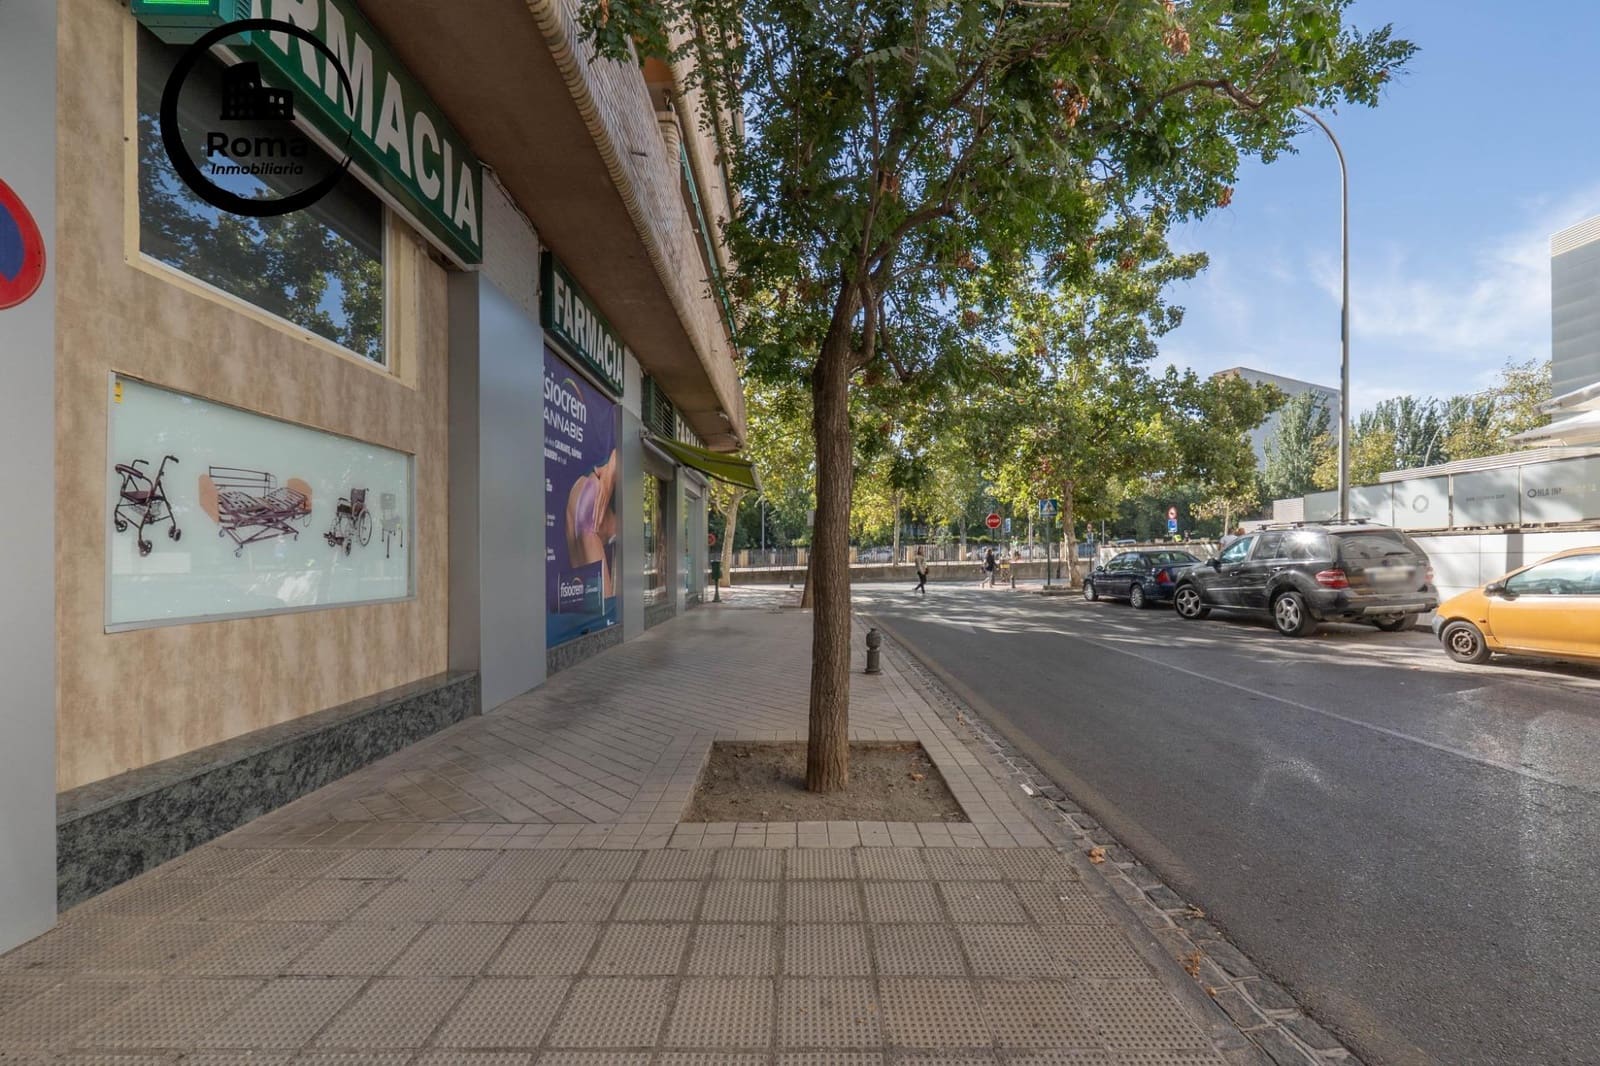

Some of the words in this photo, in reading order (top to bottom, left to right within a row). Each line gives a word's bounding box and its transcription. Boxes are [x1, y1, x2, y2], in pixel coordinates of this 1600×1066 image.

[251, 0, 479, 246] RMACIA
[553, 271, 624, 388] FARMACIA
[544, 371, 587, 424] siocrem
[544, 407, 584, 442] ANNABIS
